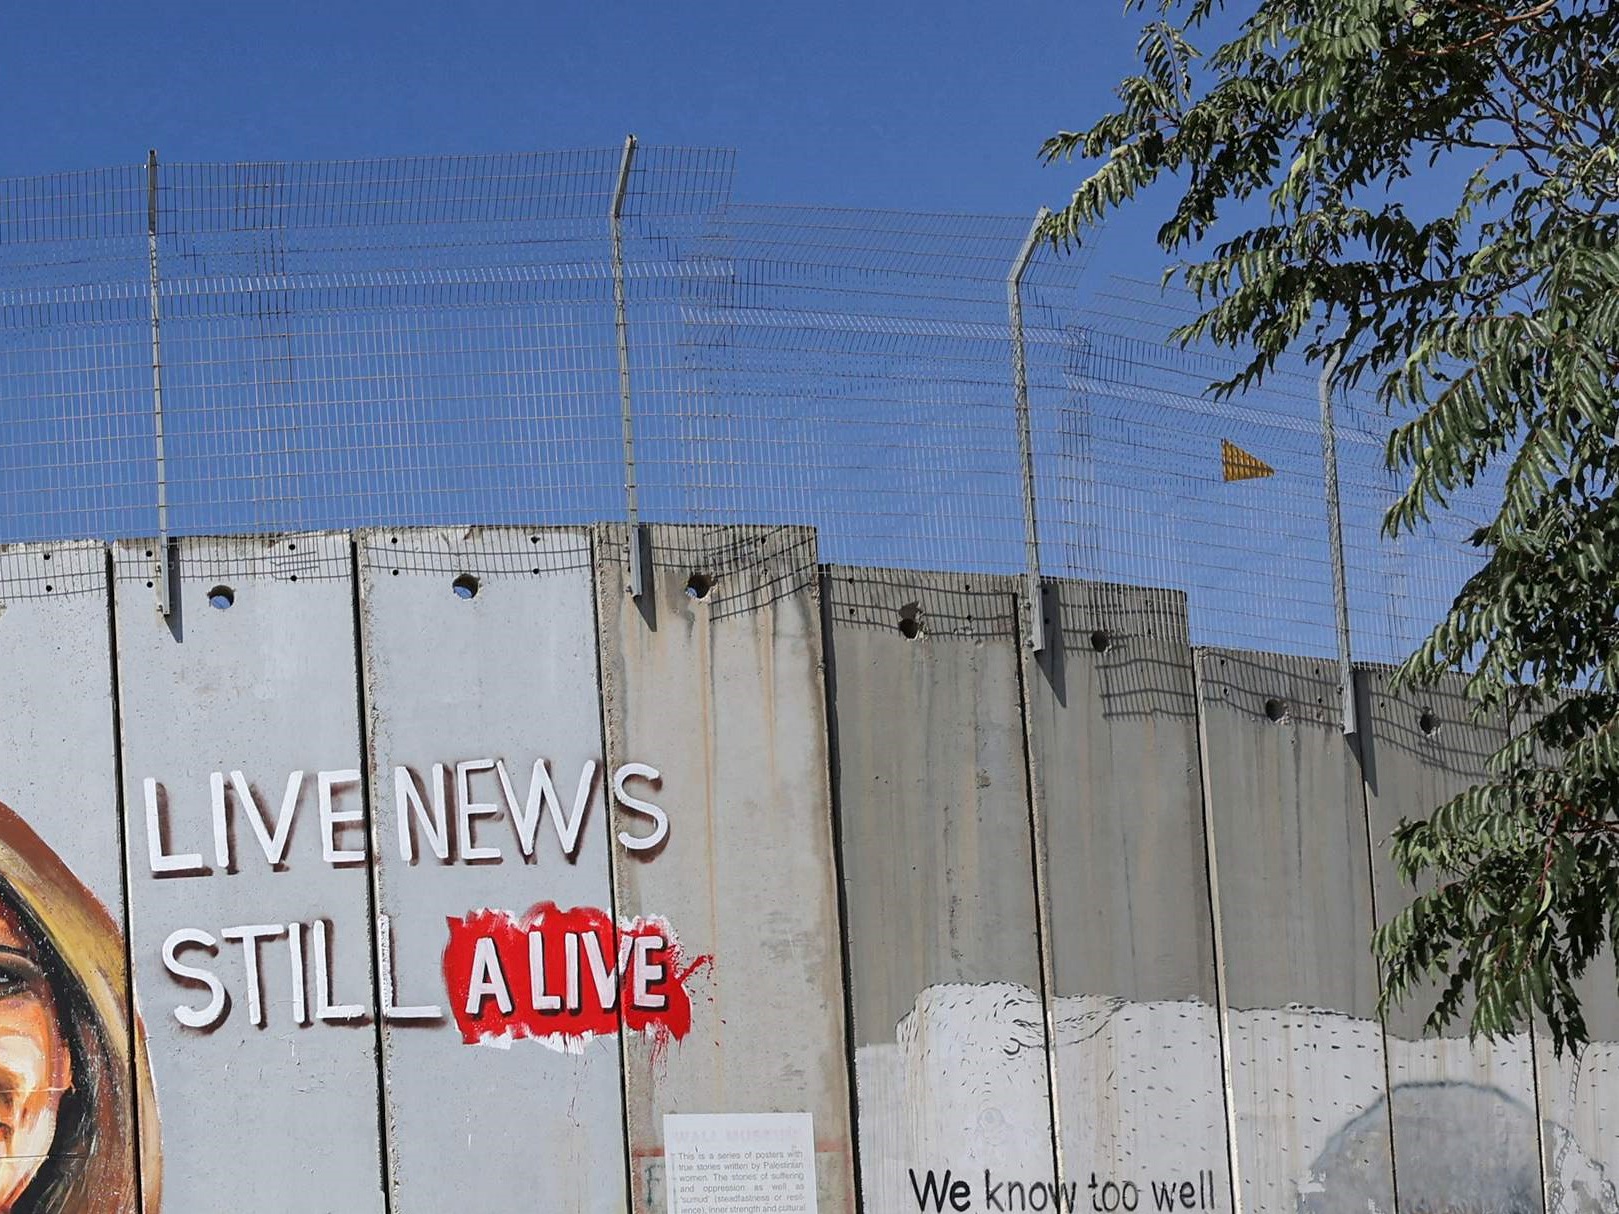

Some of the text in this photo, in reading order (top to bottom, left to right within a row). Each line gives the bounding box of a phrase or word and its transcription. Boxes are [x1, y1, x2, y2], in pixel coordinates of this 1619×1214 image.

[143, 757, 671, 873] LIVE NEWS
[161, 914, 444, 1029] STILL
[909, 1168, 1216, 1214] We know too well
